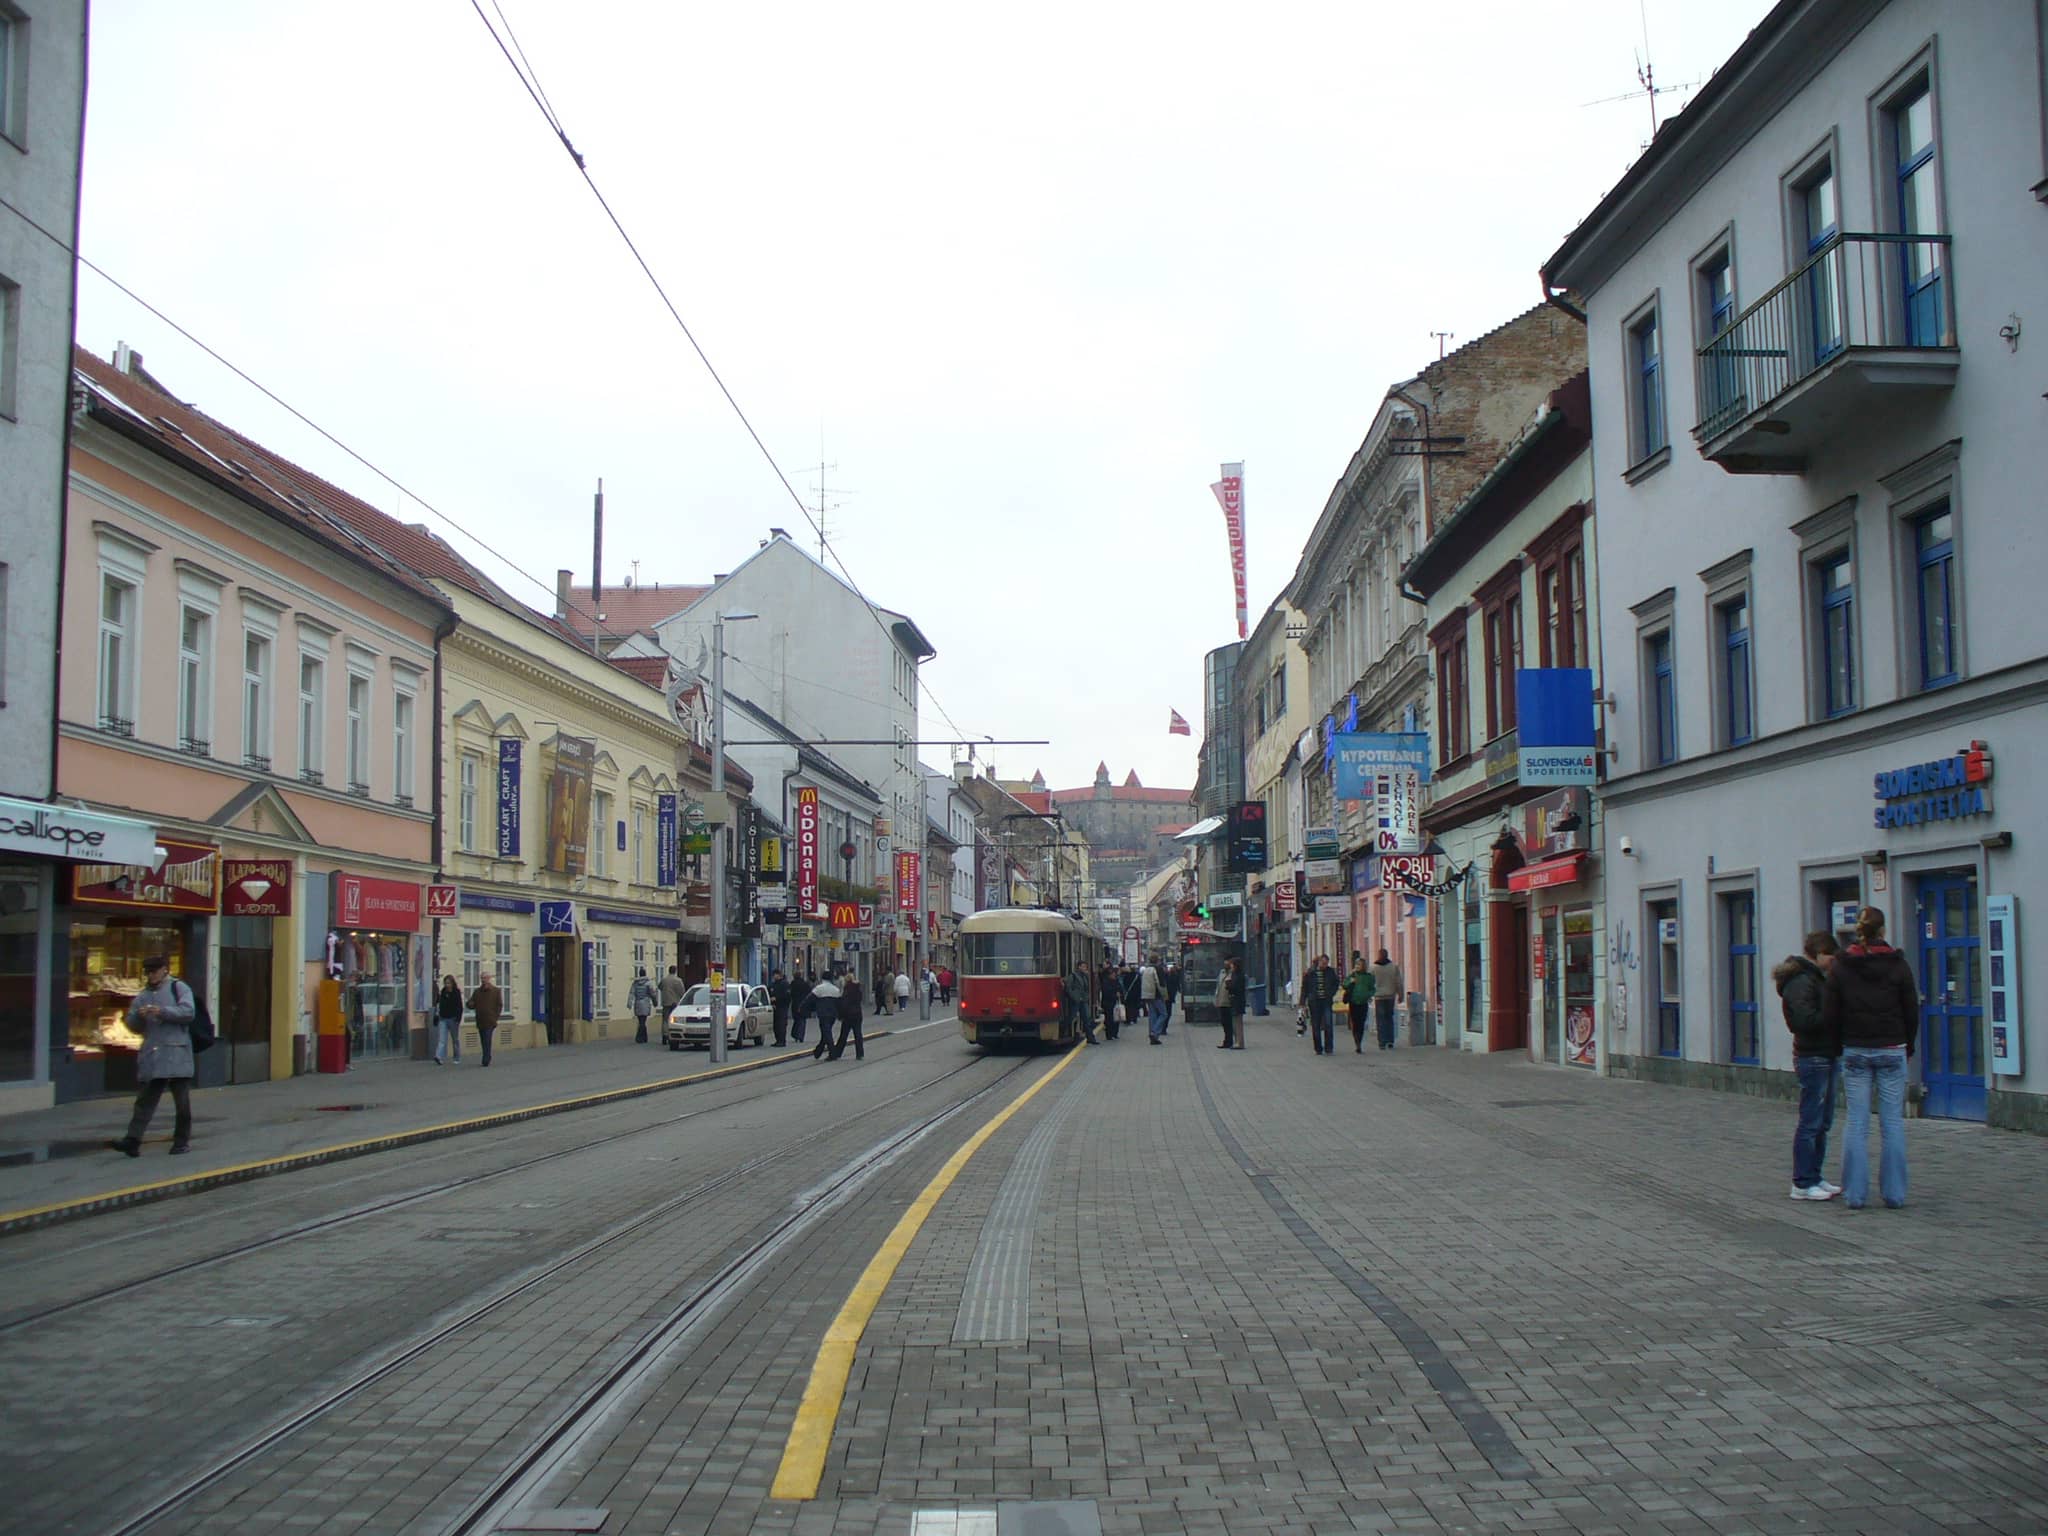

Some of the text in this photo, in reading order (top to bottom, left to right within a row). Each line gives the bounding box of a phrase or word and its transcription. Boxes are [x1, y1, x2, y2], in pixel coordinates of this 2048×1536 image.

[502, 768, 510, 854] FOLK ART CRAFT
[0, 810, 105, 855] calliope
[1378, 831, 1399, 851] 0%
[1382, 857, 1433, 875] MOBIL
[429, 889, 456, 907] AZ
[1000, 961, 1008, 971] 9
